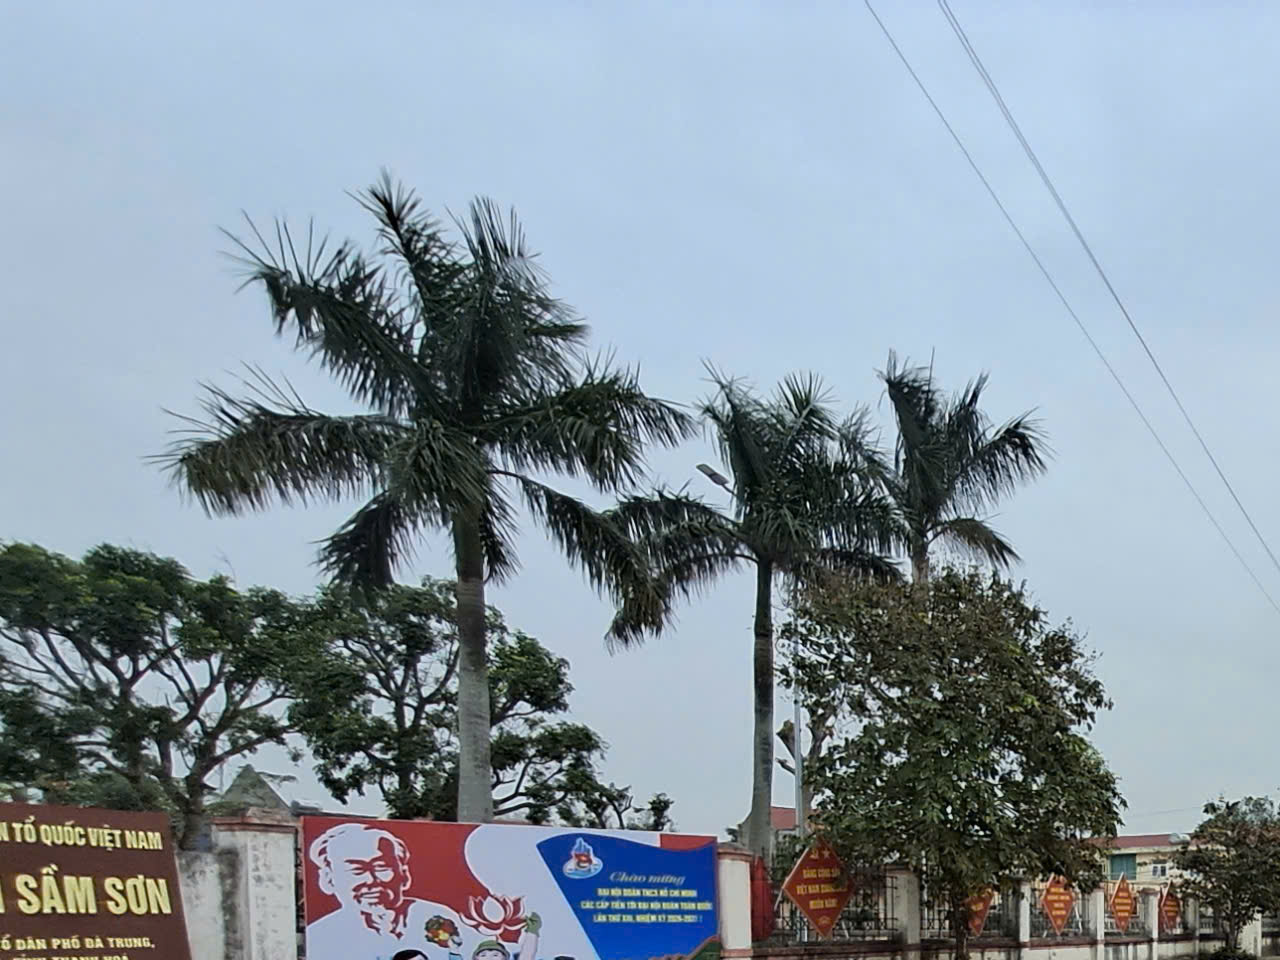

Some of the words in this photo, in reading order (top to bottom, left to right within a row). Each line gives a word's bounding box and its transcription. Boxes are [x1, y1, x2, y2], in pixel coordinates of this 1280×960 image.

[11, 815, 37, 843] TỔ
[39, 820, 87, 847] QUỐC
[87, 824, 122, 851] VIỆT
[124, 830, 163, 850] NAM
[15, 863, 98, 915] SẦM
[104, 874, 172, 916] SƠN
[15, 936, 48, 951] DÂN
[51, 935, 81, 950] PHỐ
